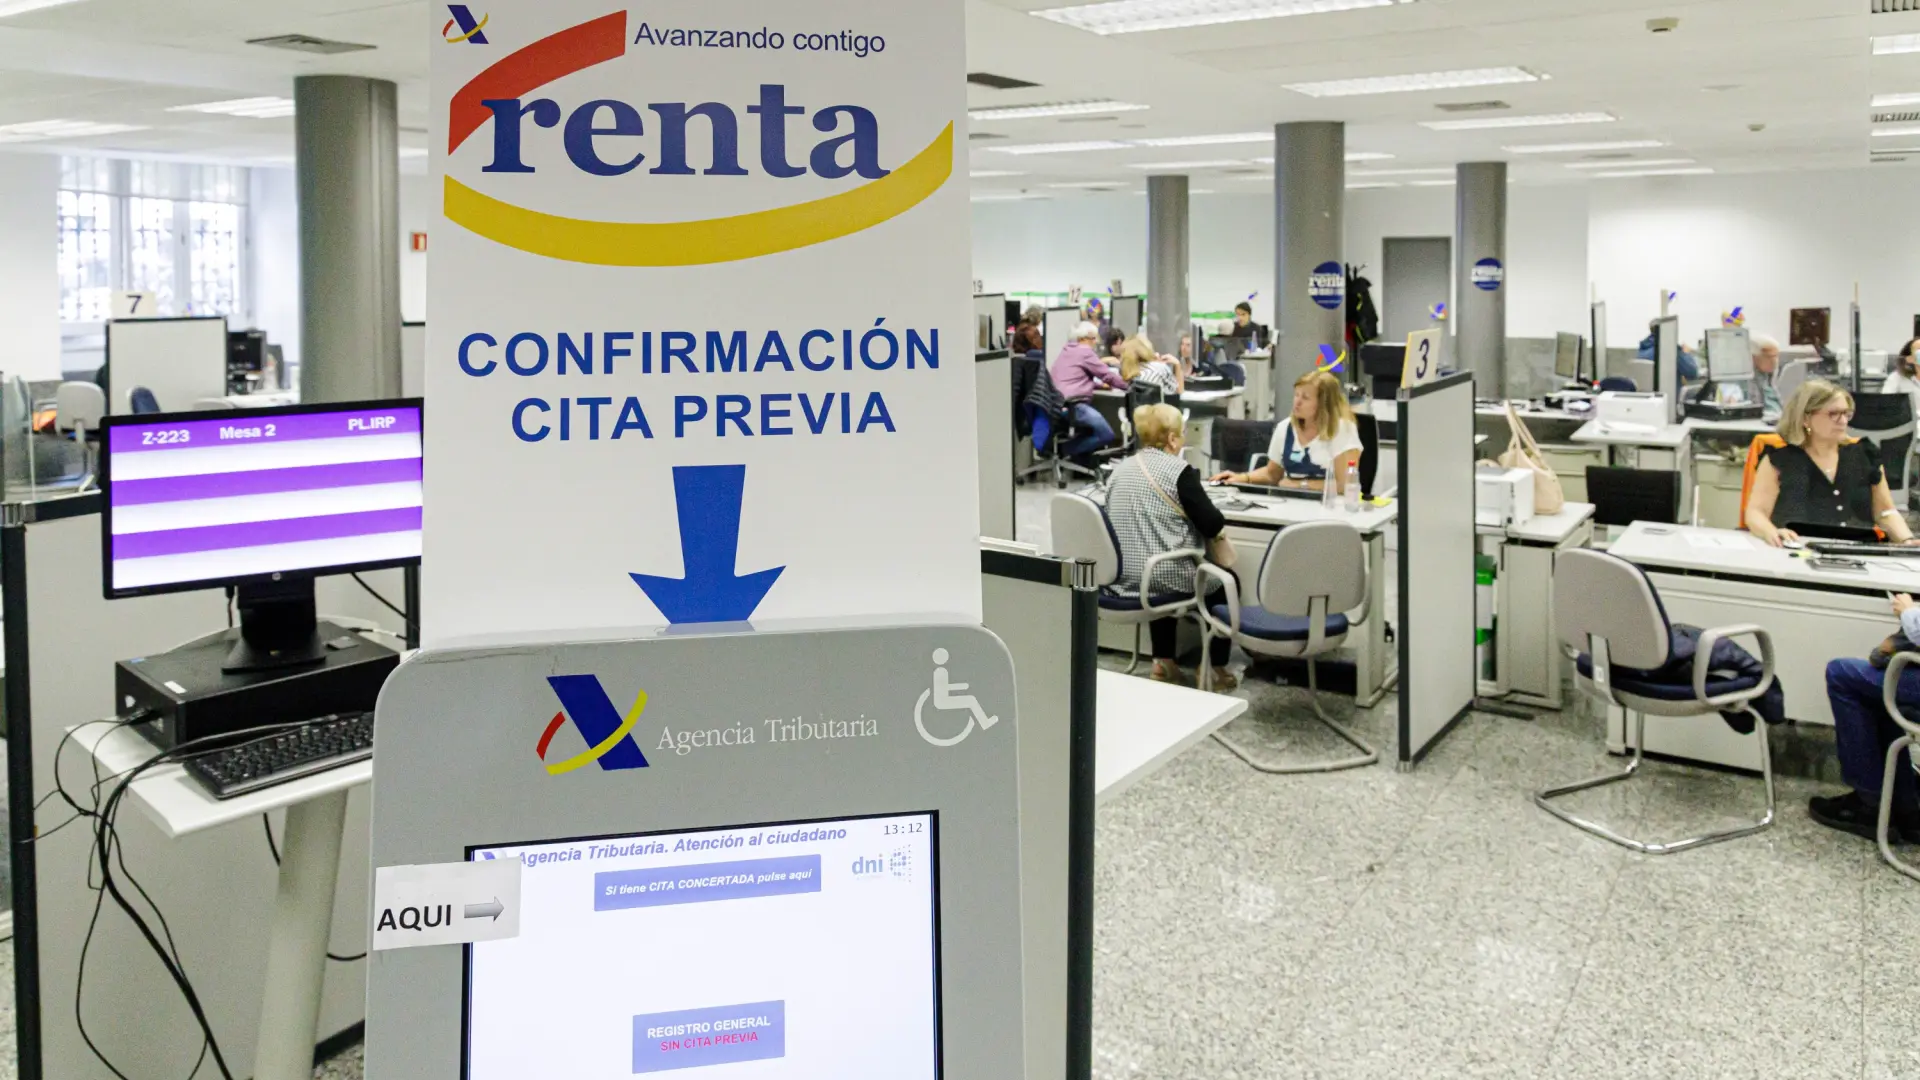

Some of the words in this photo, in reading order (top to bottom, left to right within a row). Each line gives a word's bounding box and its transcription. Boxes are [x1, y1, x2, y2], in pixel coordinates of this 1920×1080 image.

[634, 22, 785, 50] Avanzando
[793, 29, 886, 58] contigo
[481, 84, 891, 180] renta
[126, 294, 142, 314] 7
[458, 318, 940, 377] CONFIRMACIÓN
[1416, 338, 1429, 379] 3
[142, 429, 190, 445] Z-223
[219, 427, 261, 440] Mesa
[265, 424, 277, 437] 2
[348, 416, 396, 430] PL.IRP
[512, 396, 655, 443] CITA
[674, 391, 897, 438] PREVIA
[656, 721, 756, 756] Agencia
[764, 714, 879, 743] Tributaria
[884, 822, 923, 835] 13:12
[520, 848, 582, 867] Agencia
[588, 841, 669, 859] Tributaria.
[674, 834, 744, 852] Atención
[749, 832, 763, 846] al
[767, 828, 847, 845] ciudadano
[852, 853, 883, 875] dni
[620, 883, 646, 894] tiene
[649, 880, 675, 892] CITA
[678, 874, 755, 889] CONCERTADA
[757, 871, 786, 884] pulse
[376, 904, 452, 932] AQUI
[647, 1022, 711, 1039] REGISTRO
[714, 1015, 771, 1032] GENERAL
[660, 1041, 680, 1051] SIN
[684, 1036, 712, 1049] CITA
[715, 1031, 758, 1046] PREVIA
